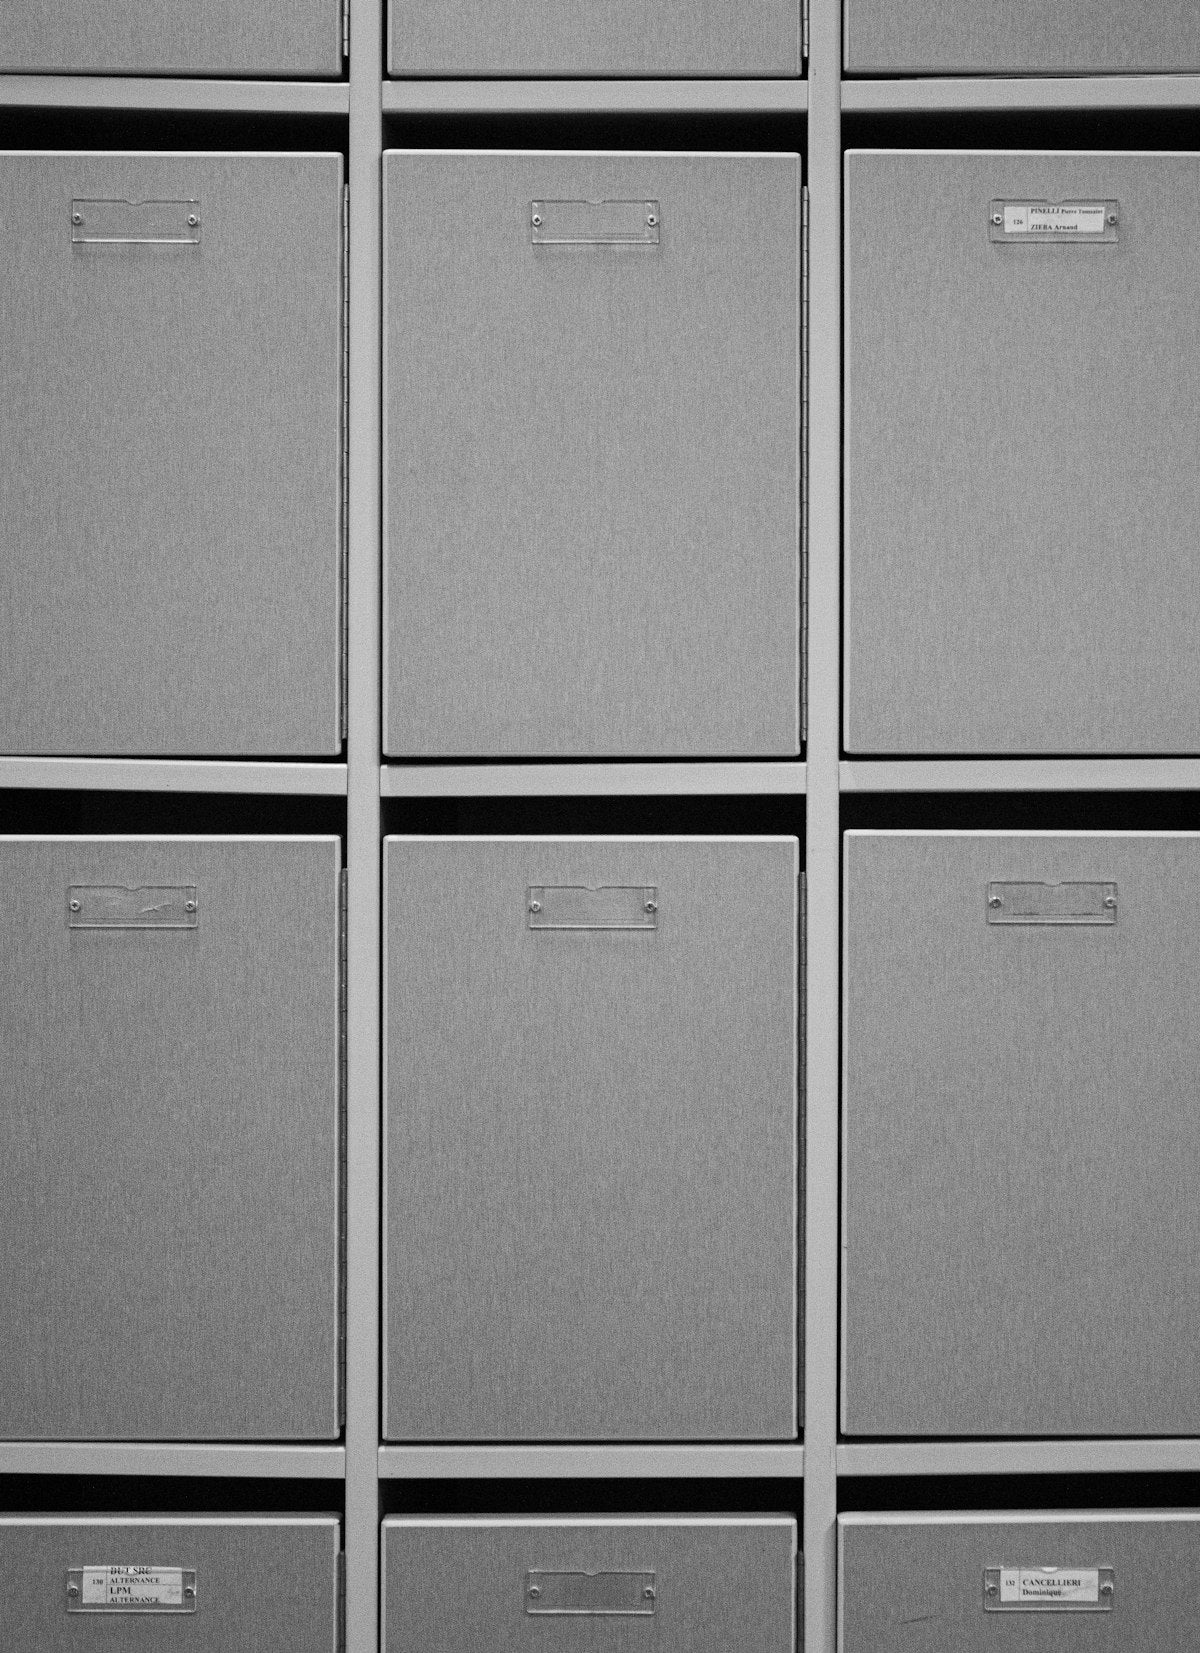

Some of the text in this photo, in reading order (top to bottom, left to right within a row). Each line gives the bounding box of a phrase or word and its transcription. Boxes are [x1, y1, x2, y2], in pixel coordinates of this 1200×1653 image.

[1022, 1579, 1081, 1587] CANCELLIERI
[110, 1586, 131, 1595] LPM
[1022, 1588, 1062, 1597] Dominique
